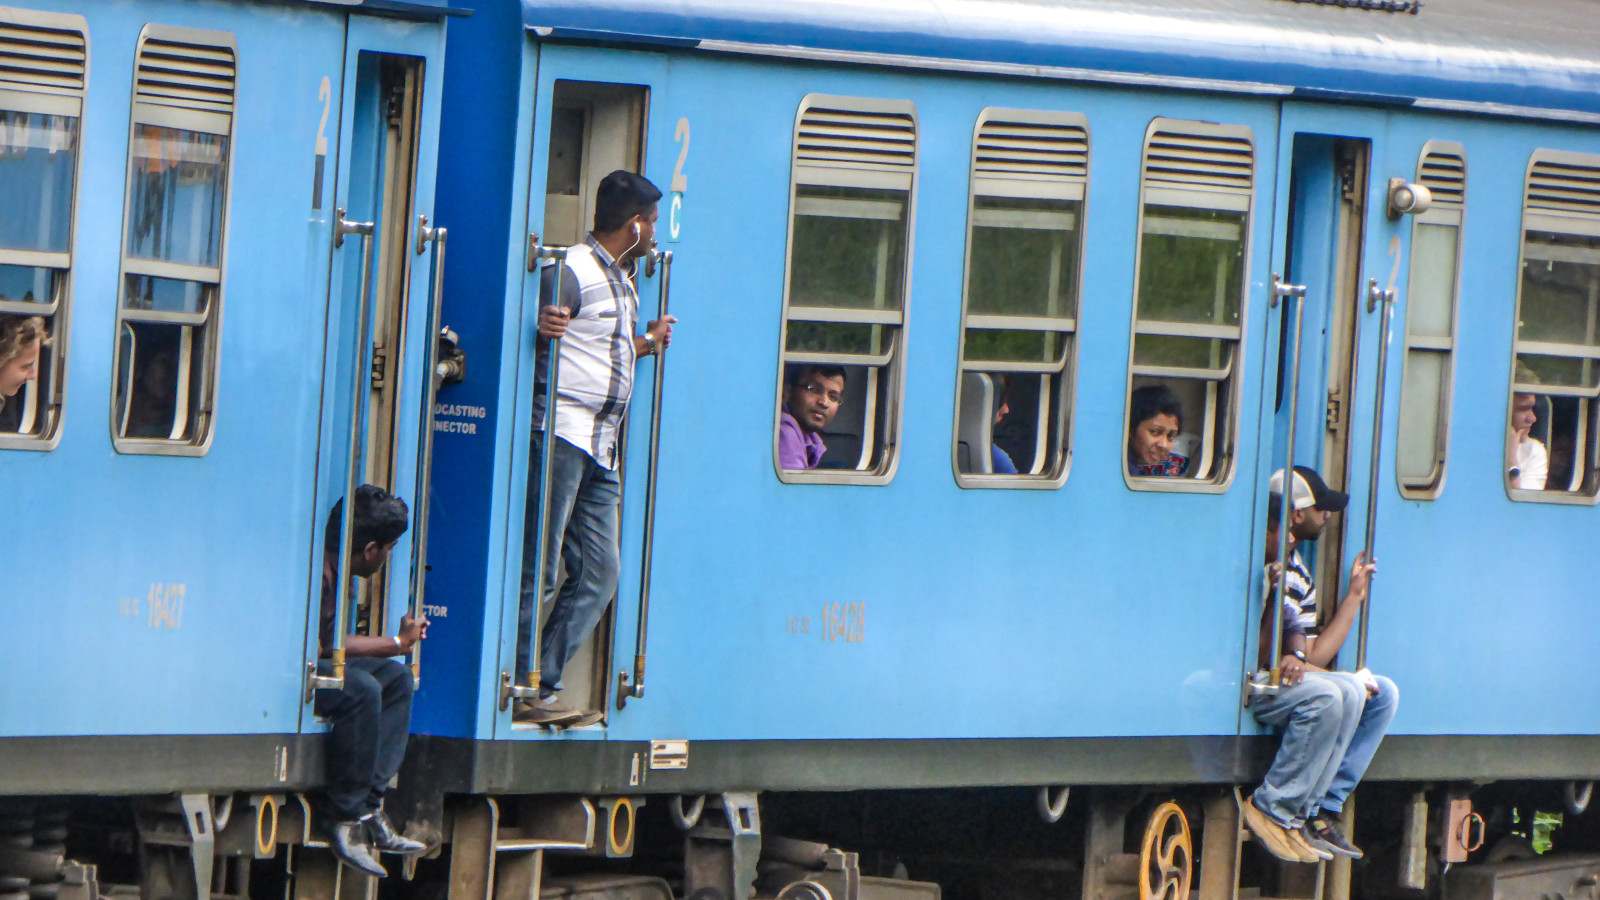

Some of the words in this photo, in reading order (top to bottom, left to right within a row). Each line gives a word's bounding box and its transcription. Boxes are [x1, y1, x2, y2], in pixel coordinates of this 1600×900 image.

[315, 75, 331, 156] 2
[672, 117, 690, 192] 2
[670, 195, 681, 239] C
